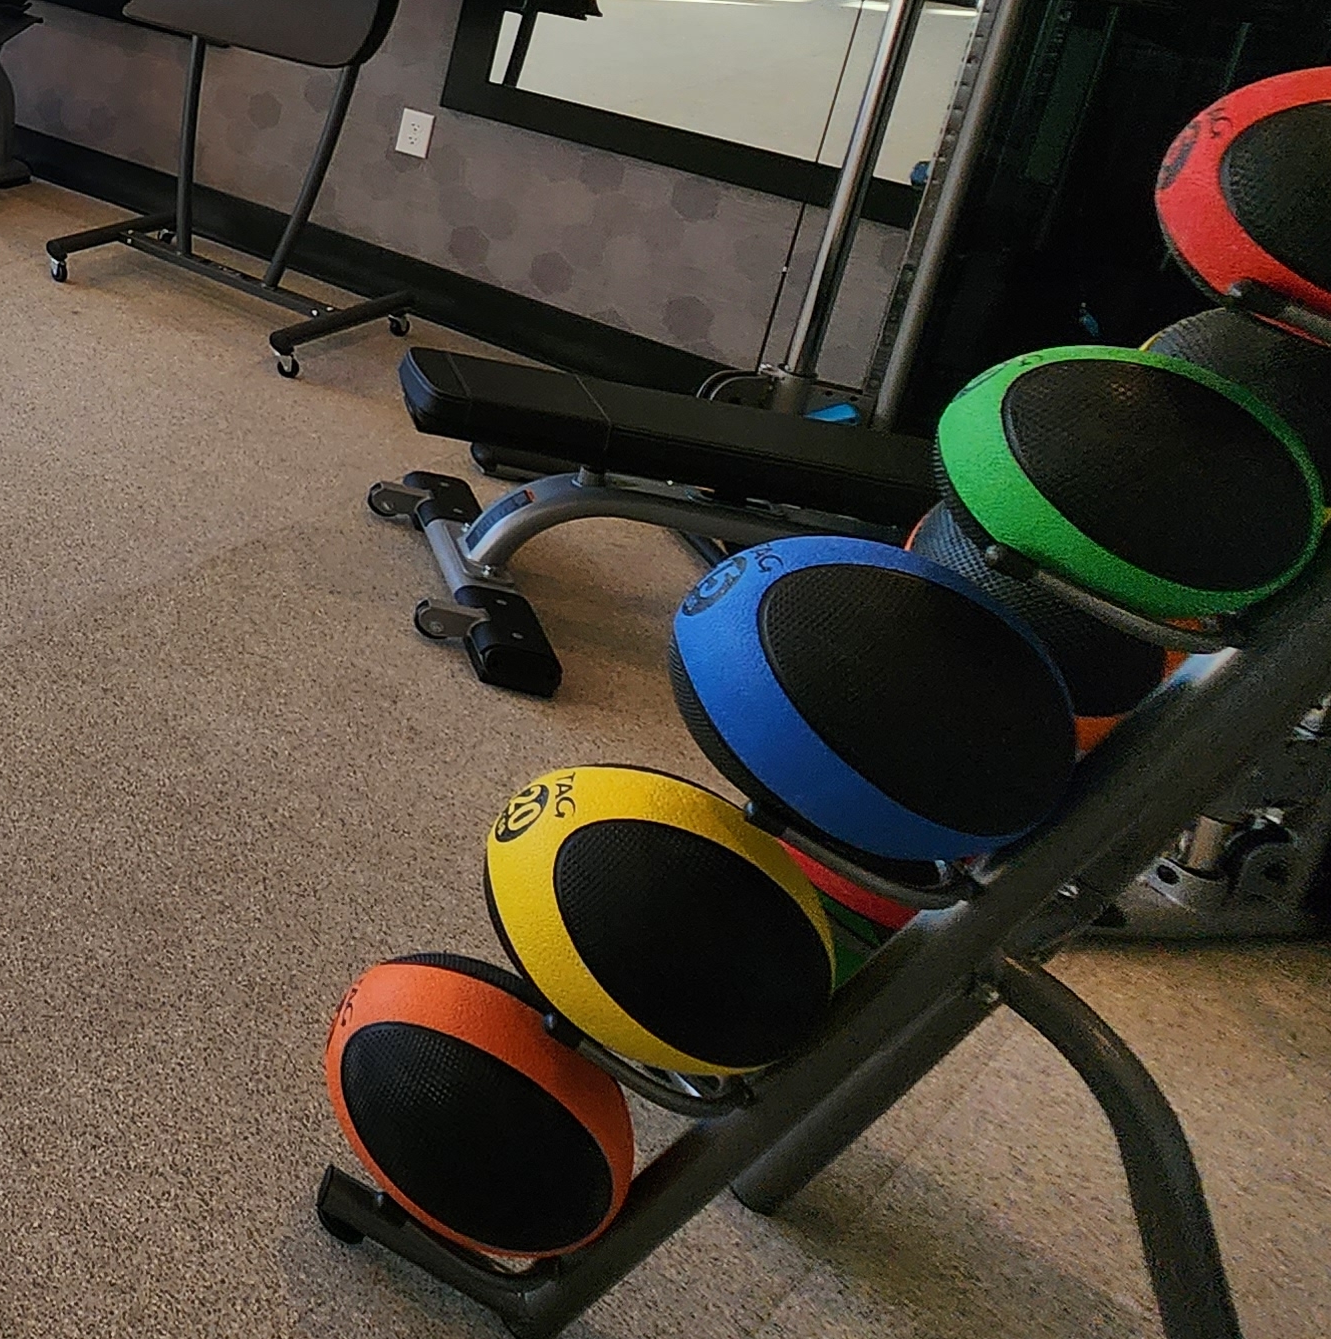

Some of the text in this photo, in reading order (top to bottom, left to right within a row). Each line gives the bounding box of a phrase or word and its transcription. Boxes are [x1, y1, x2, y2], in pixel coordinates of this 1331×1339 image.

[749, 543, 785, 574] AG
[507, 785, 542, 831] 20
[554, 771, 577, 819] TAG
